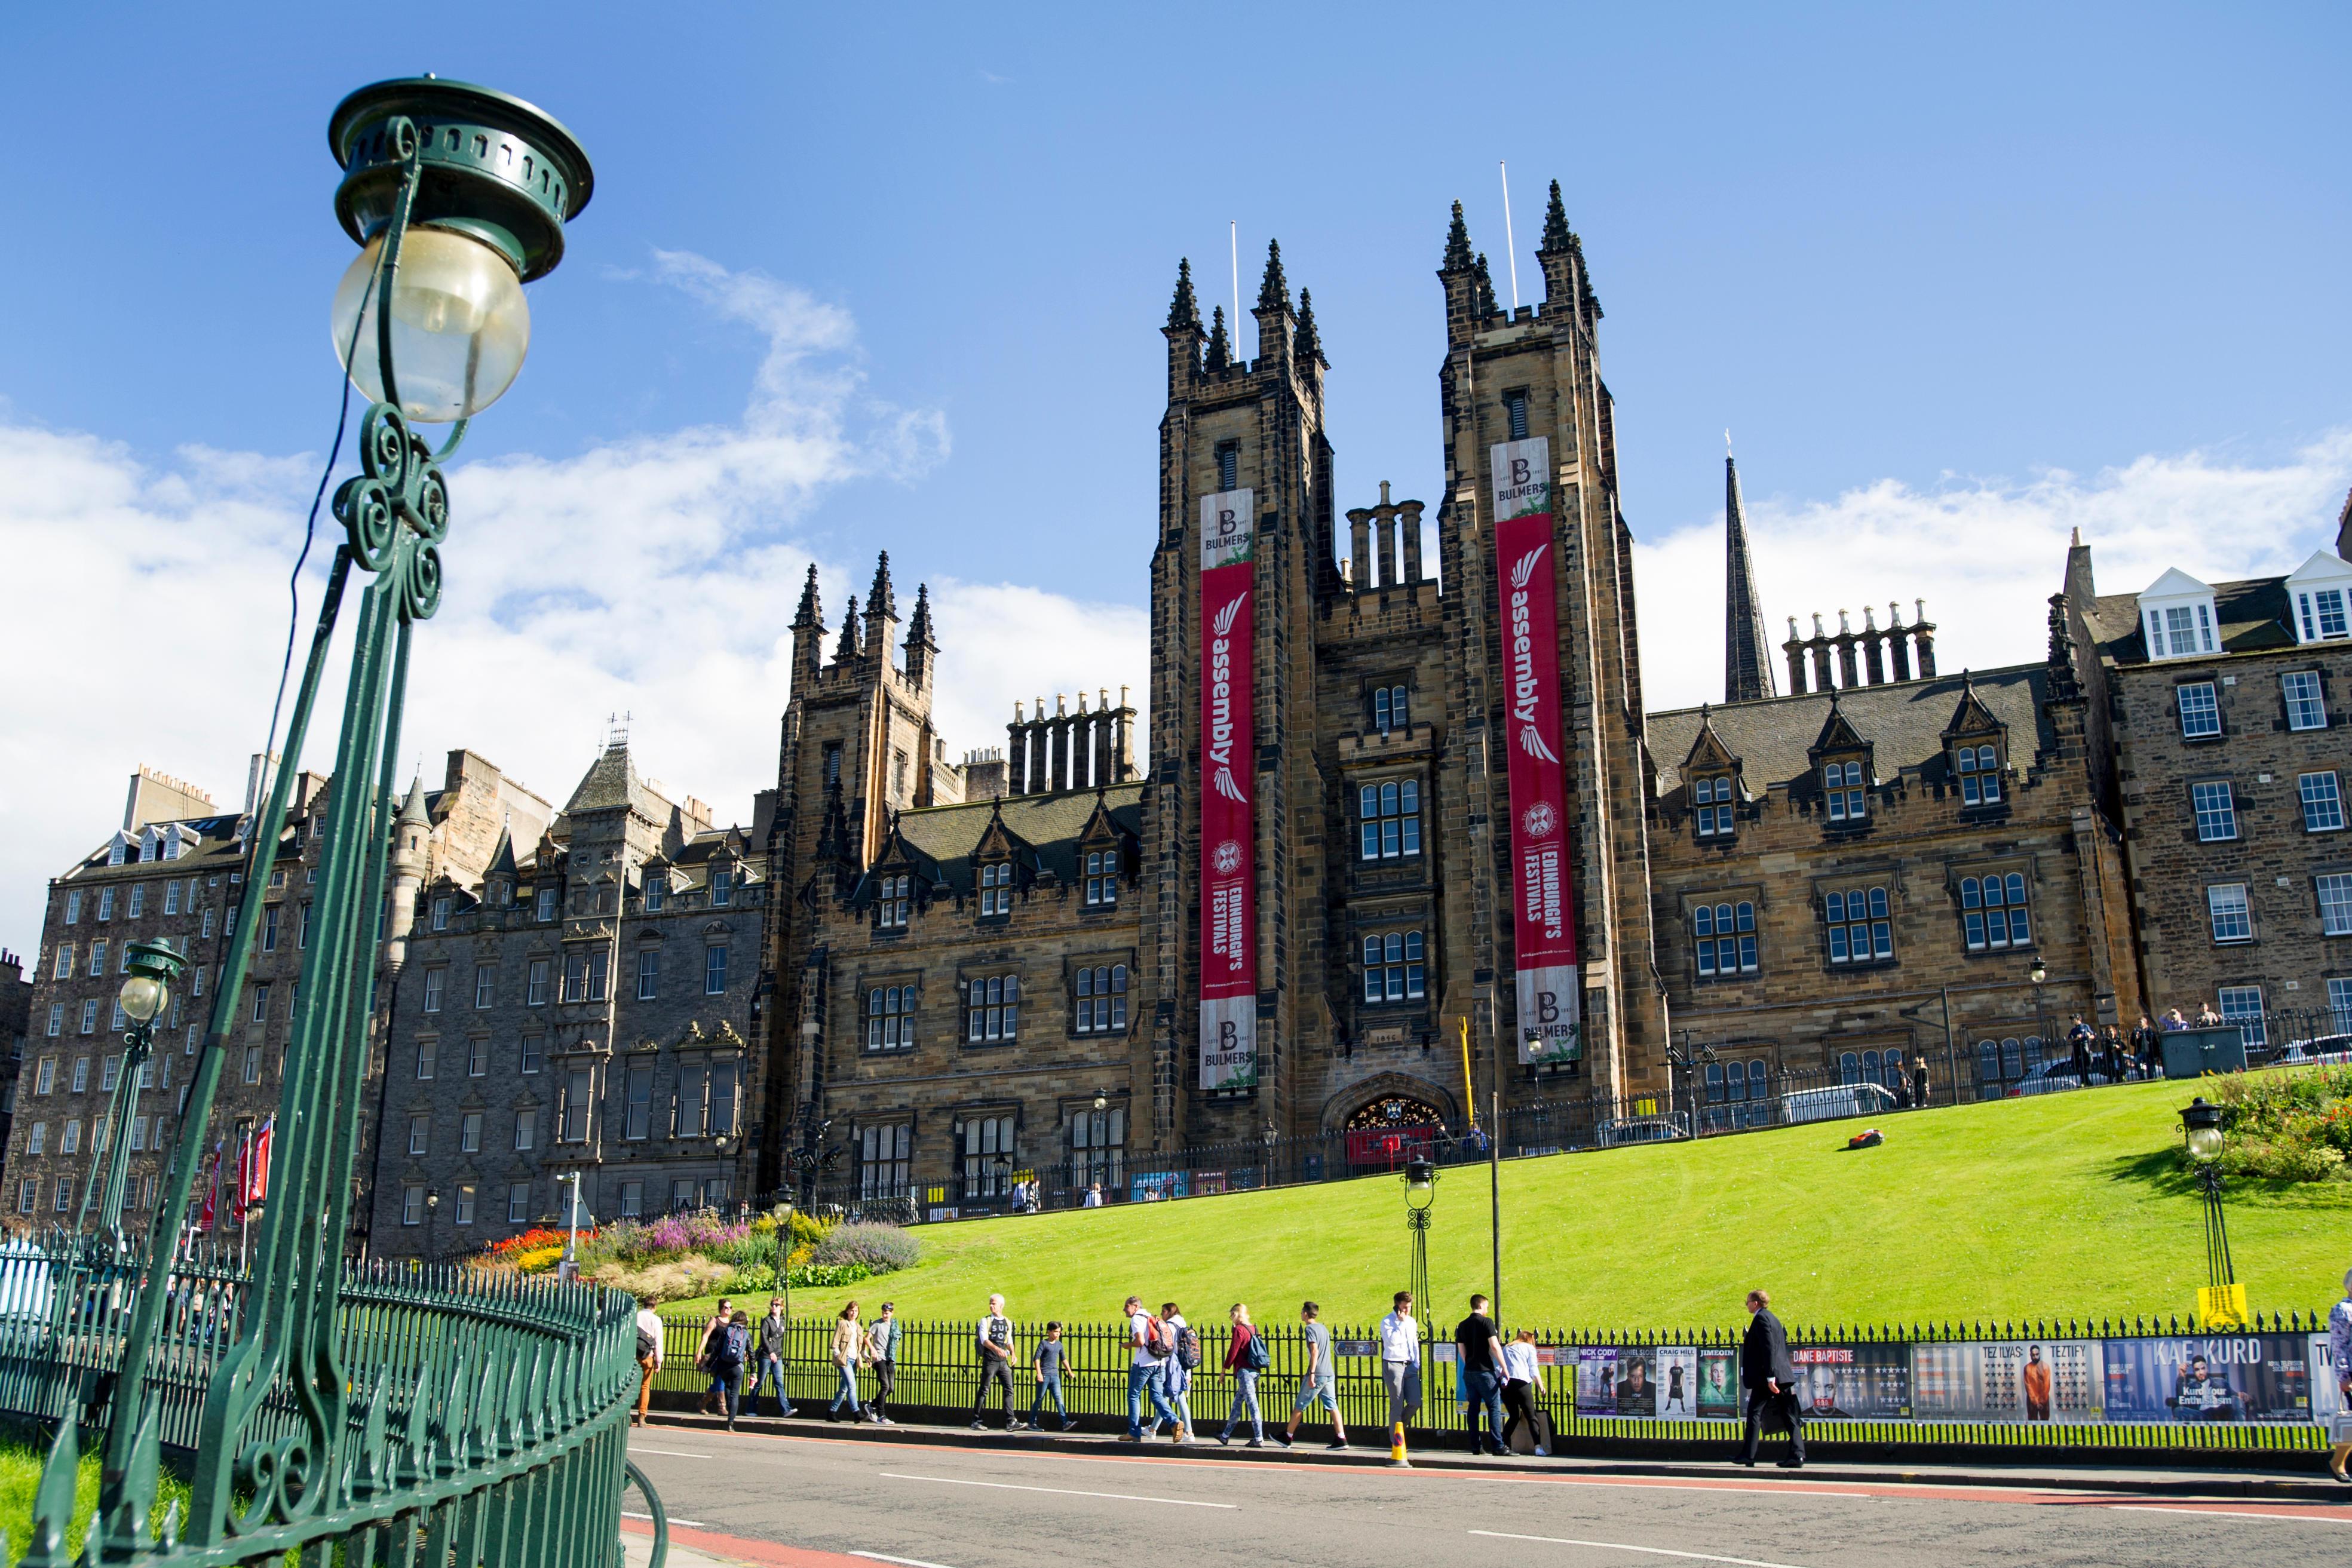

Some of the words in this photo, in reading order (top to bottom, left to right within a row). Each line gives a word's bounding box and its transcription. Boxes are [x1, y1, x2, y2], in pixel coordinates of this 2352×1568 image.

[1498, 483, 1545, 502] BULMERS
[1206, 533, 1249, 550] BULMERS
[1511, 590, 1539, 723] assembly
[1210, 638, 1233, 765] assembly
[1525, 854, 1541, 922] FESTIVALS
[1543, 851, 1562, 938] EDINBURGH'S
[1213, 889, 1227, 955] FESTIVALS
[1229, 886, 1243, 971] EDINBURGH'S
[1205, 1051, 1252, 1067] BULMERS
[1793, 1350, 1814, 1362] DANE
[1816, 1349, 1853, 1362] BAPTISTE
[1983, 1346, 1997, 1358] TEZ
[1999, 1346, 2023, 1358] ILYAS:
[2050, 1345, 2086, 1357] TEZTIFY
[2153, 1339, 2193, 1366] KAE
[2202, 1338, 2261, 1364] KURD
[2179, 1395, 2232, 1404] Enthusiasm
[2183, 1386, 2204, 1395] Kurd
[2204, 1386, 2226, 1395] Your
